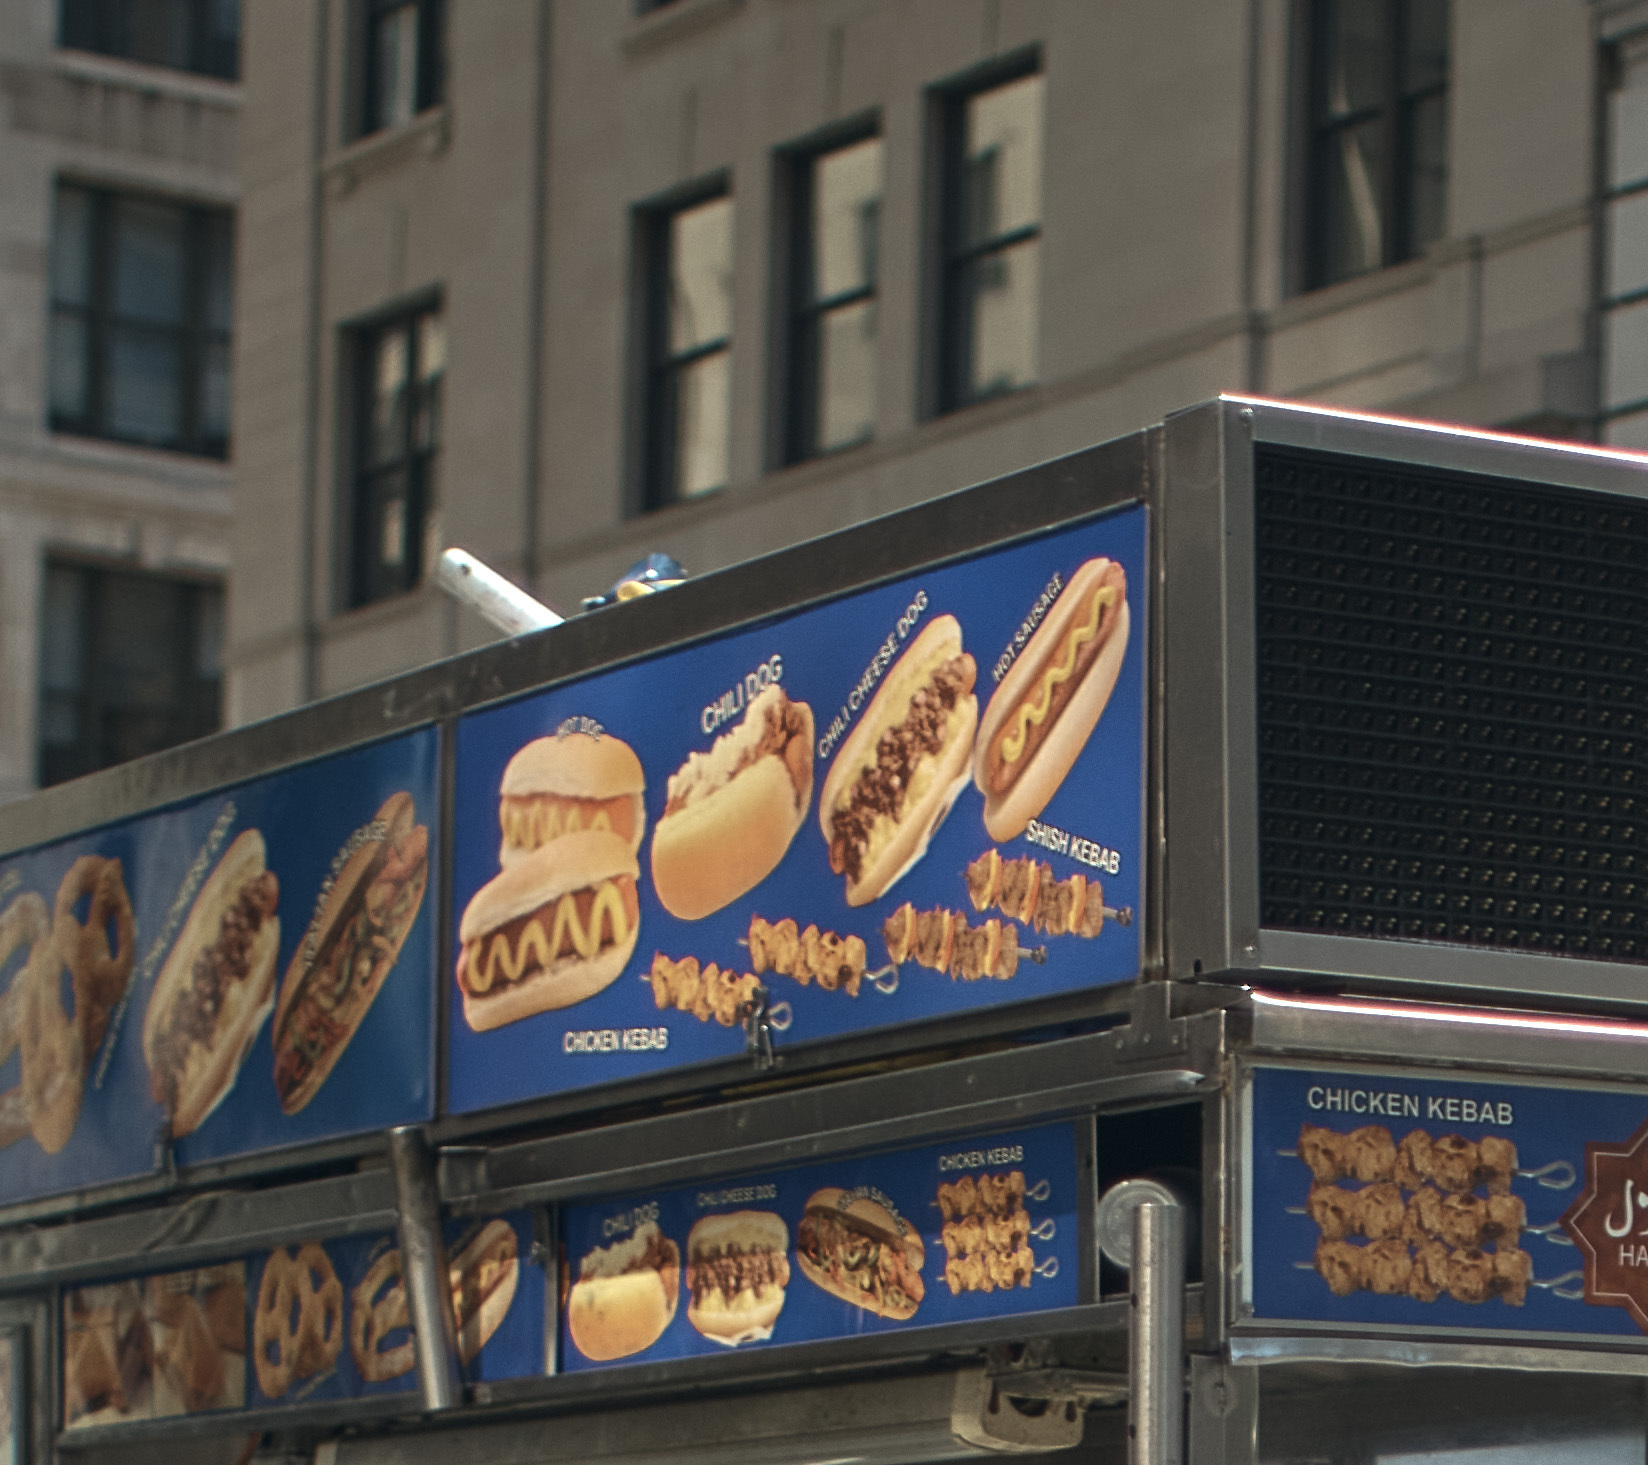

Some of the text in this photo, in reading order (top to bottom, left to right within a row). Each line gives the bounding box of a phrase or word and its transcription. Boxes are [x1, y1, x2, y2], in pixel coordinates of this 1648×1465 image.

[992, 573, 1065, 682] HOT SAUSAGE
[702, 653, 784, 735] CHILI DOG
[817, 590, 928, 758] CHILI CHEESE DOG
[1024, 819, 1121, 875] SHISH KEBAB
[563, 1027, 669, 1054] CHICKEN KEBAB
[1307, 1086, 1514, 1126] CHICKEN KEBAB
[938, 1145, 1025, 1173] CHICKEN KEBAB
[602, 1200, 660, 1238] CHILI DOG
